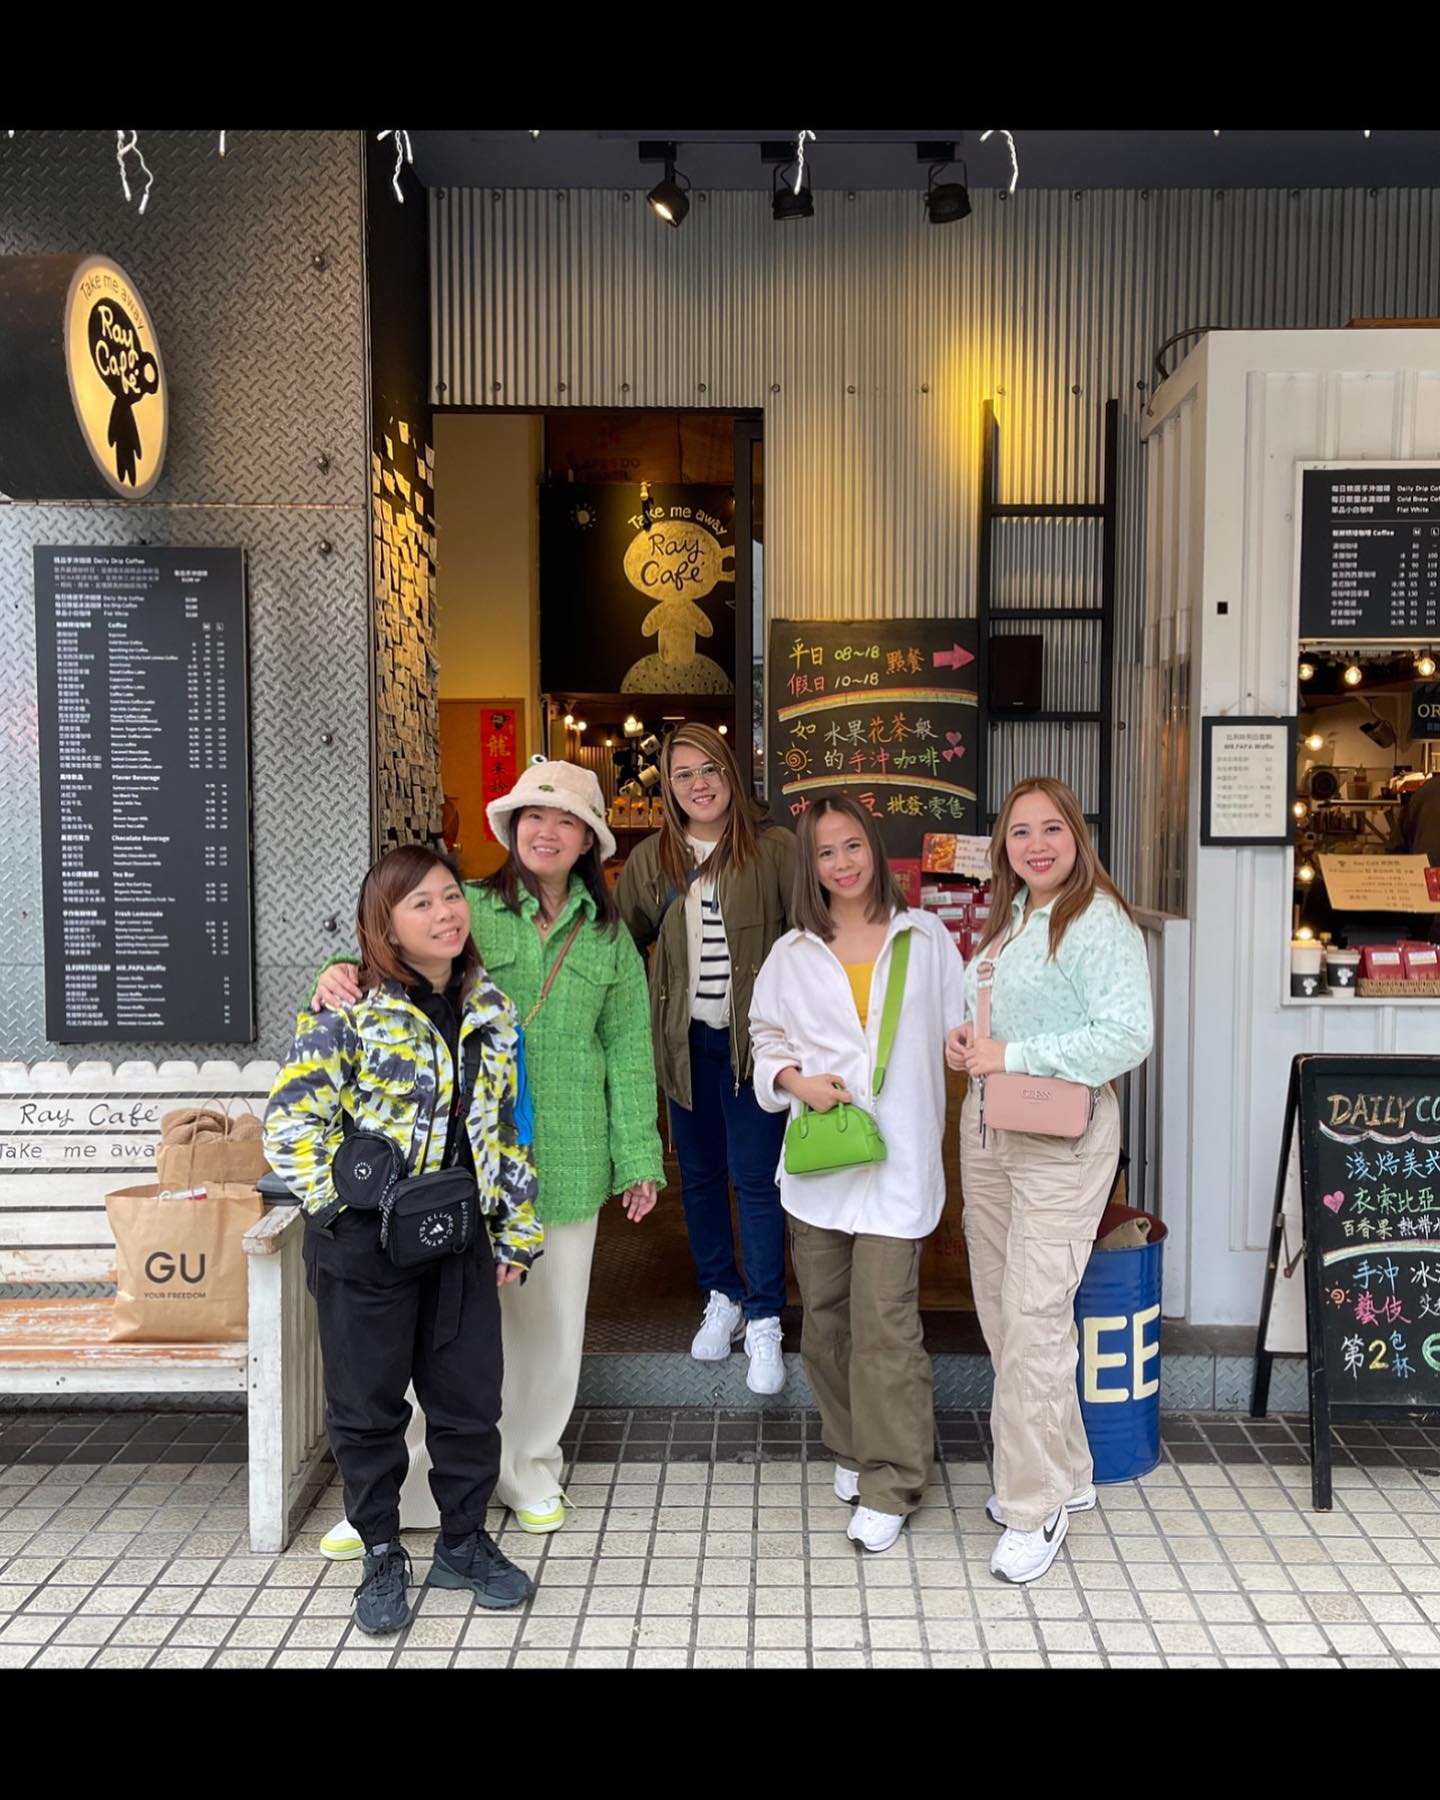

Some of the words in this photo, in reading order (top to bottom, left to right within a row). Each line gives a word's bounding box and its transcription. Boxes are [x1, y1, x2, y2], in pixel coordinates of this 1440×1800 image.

[80, 274, 102, 300] Take
[103, 275, 120, 294] me
[120, 287, 145, 330] away
[97, 304, 139, 369] Ray
[1396, 495, 1411, 503] Cold
[670, 505, 693, 519] me
[695, 509, 728, 536] away
[1373, 529, 1395, 537] Coffee
[648, 533, 705, 564] Ray
[640, 560, 705, 592] Café
[789, 638, 824, 670] 平日
[834, 645, 881, 661] 08~18
[787, 672, 825, 698] 假日
[834, 672, 879, 689] 10~18
[1417, 703, 1440, 718] OR
[20, 1103, 74, 1128] Ray
[89, 1102, 160, 1127] Café
[1328, 1093, 1415, 1128] DAILY
[64, 1145, 97, 1158] me
[110, 1143, 156, 1158] awa
[1341, 1217, 1393, 1240] 百香果
[144, 1251, 206, 1284] GU
